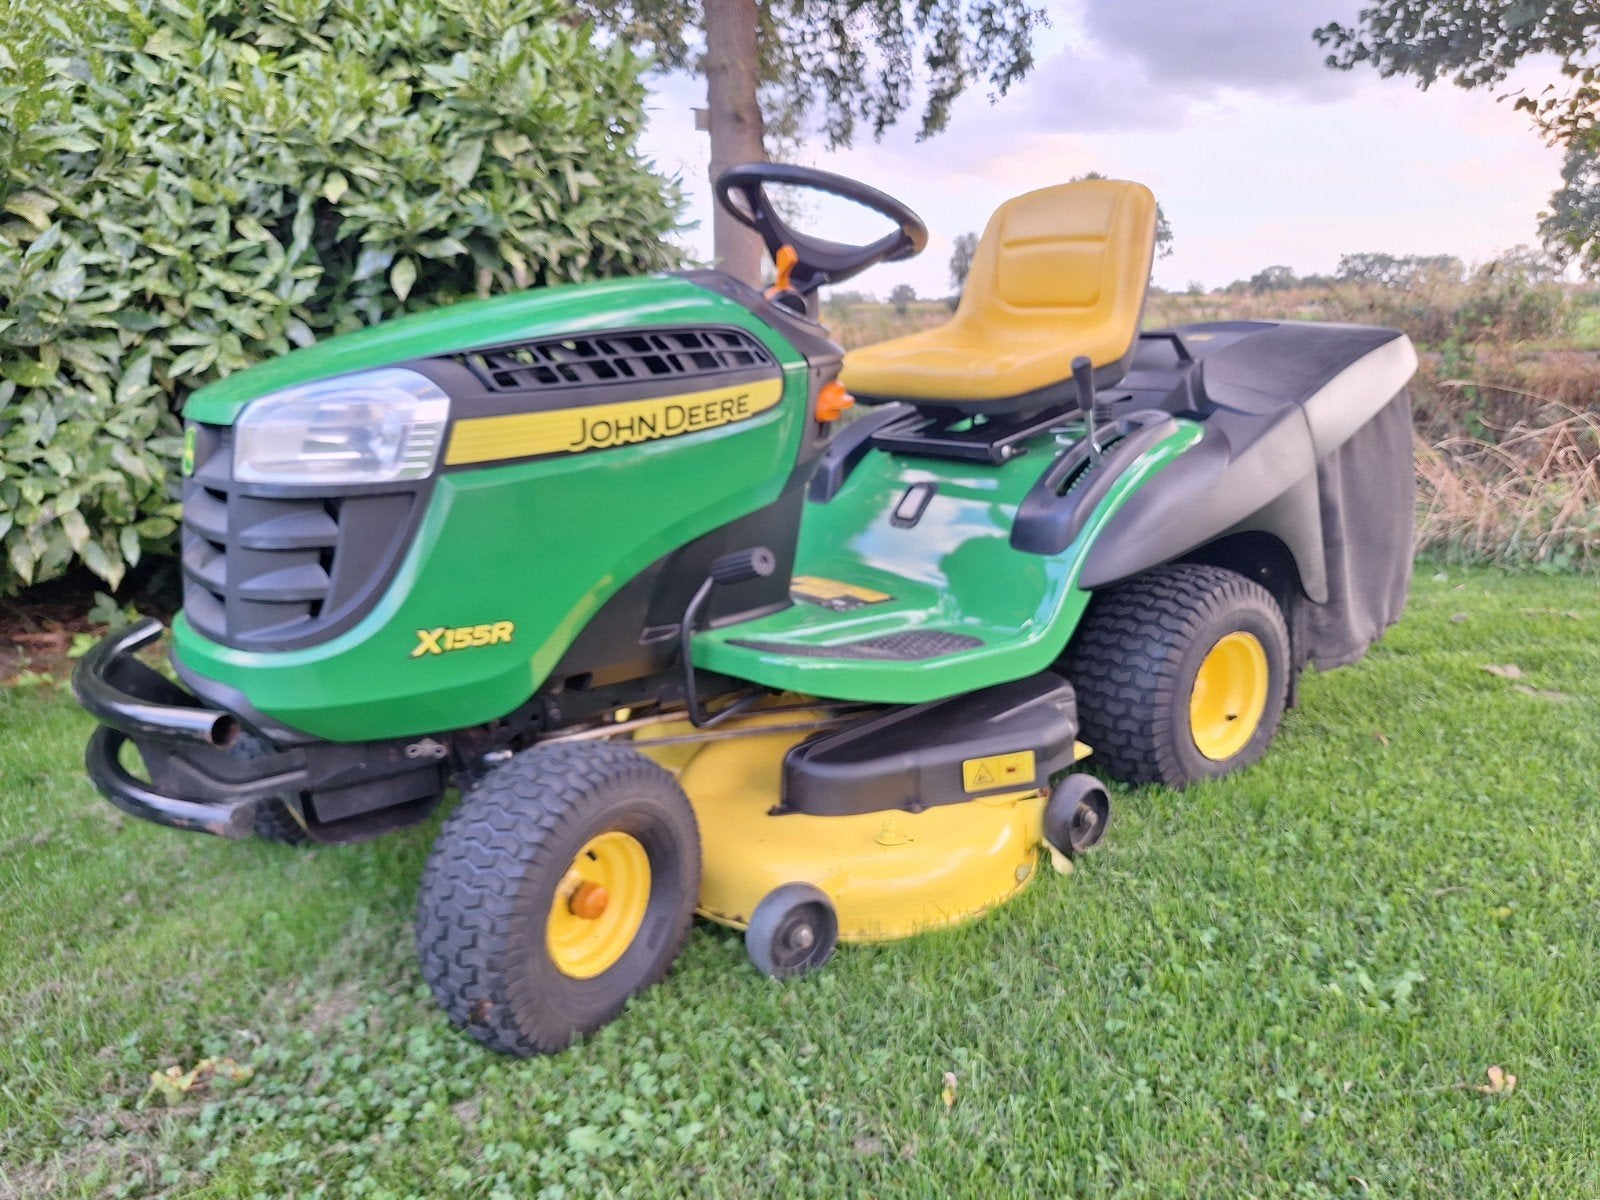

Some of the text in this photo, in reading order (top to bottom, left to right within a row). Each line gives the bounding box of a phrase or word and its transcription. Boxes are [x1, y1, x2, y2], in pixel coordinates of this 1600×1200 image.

[570, 394, 749, 446] JOHN DEERE
[410, 620, 514, 658] X155R
